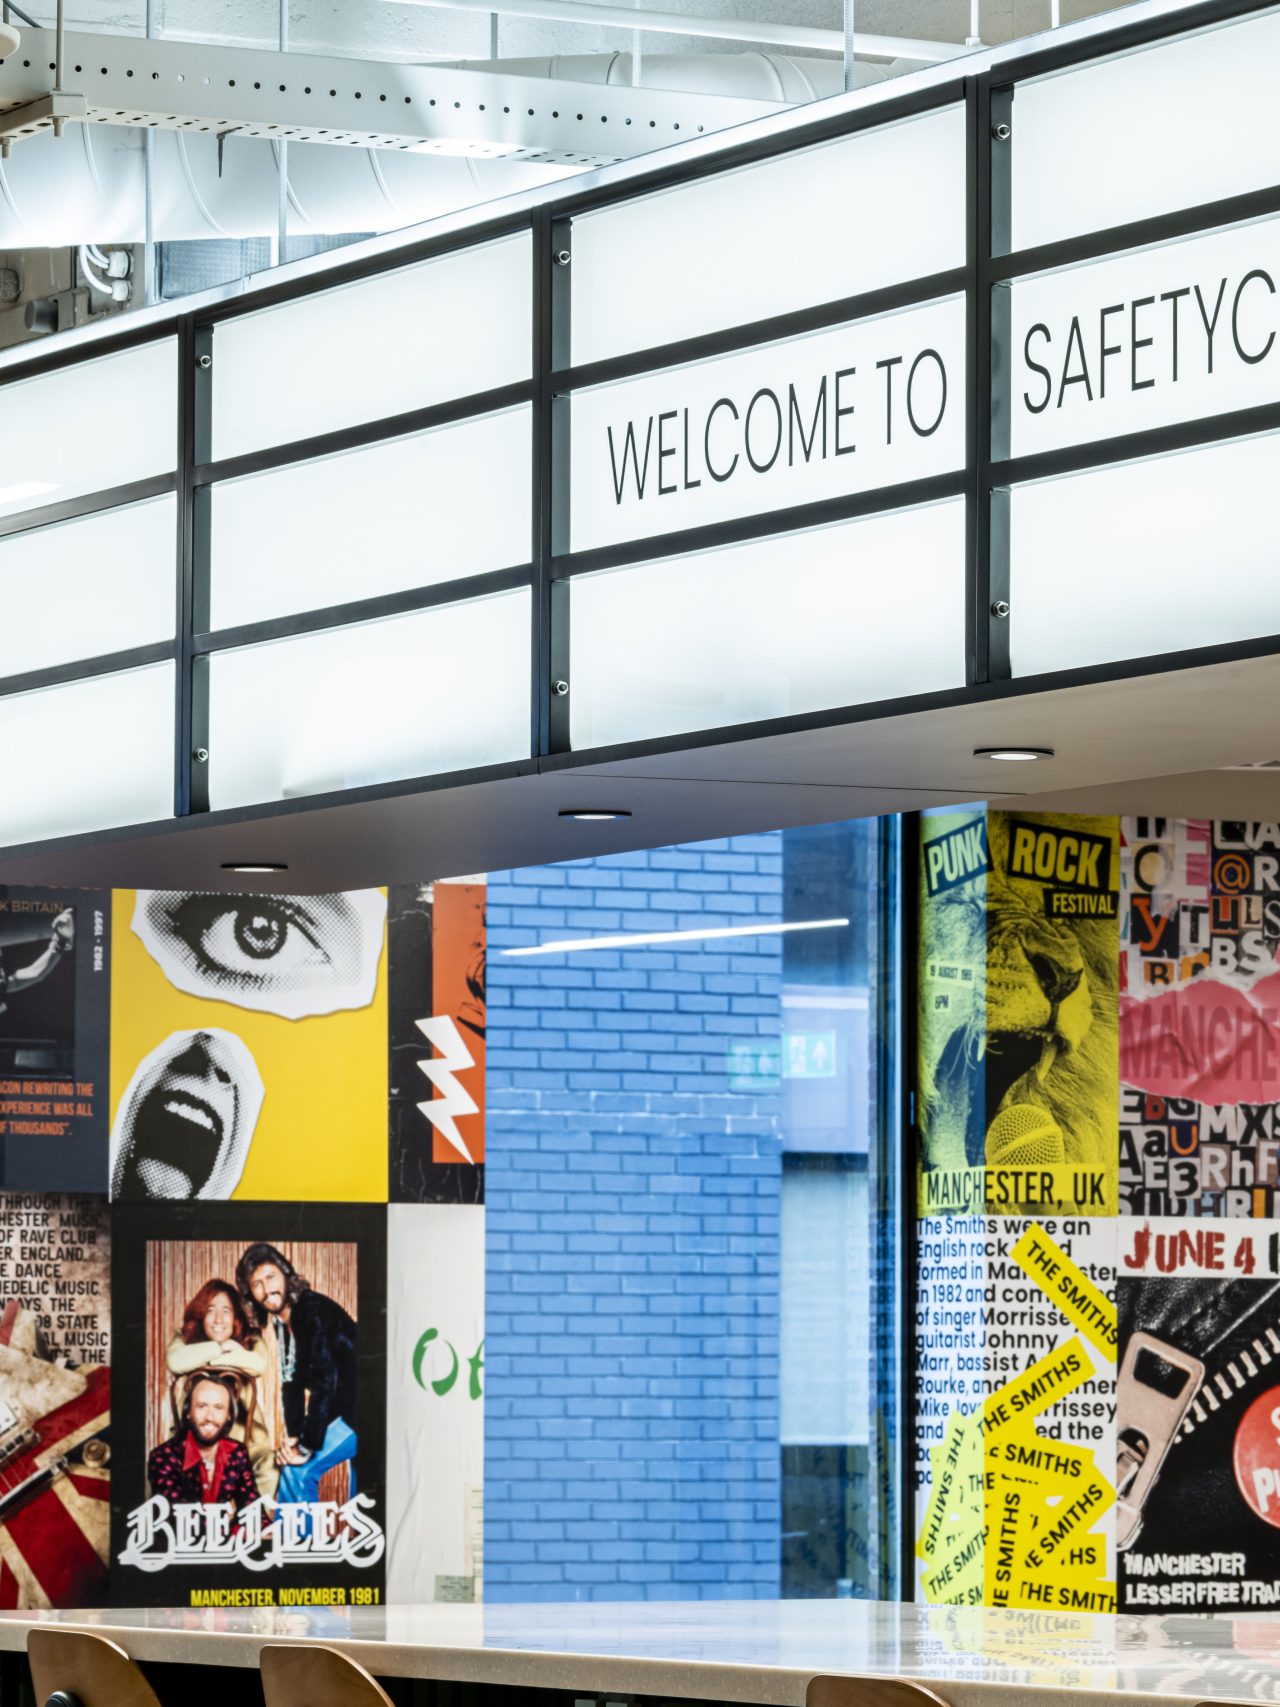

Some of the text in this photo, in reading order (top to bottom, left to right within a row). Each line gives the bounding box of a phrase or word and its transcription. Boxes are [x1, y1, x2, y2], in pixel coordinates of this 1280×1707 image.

[607, 348, 947, 505] WELCOME TO
[929, 824, 1103, 890] PUNK ROCK
[11, 901, 65, 913] BRITAIN
[1053, 893, 1115, 914] FESTIVAL
[93, 910, 104, 936] 1997
[23, 1082, 74, 1096] REWRITING
[76, 1083, 94, 1096] THE
[54, 1102, 74, 1116] WAS
[76, 1103, 93, 1117] ALL
[928, 1171, 1105, 1209] MANCHESTER, UK
[59, 1212, 104, 1228] MUSIC
[917, 1218, 942, 1235] The
[946, 1217, 998, 1234] Smiths
[1063, 1220, 1091, 1235] an
[20, 1230, 55, 1245] RAVE
[61, 1230, 97, 1245] CLUB
[1124, 1219, 1225, 1272] JUNE
[1234, 1237, 1256, 1275] 4
[917, 1240, 967, 1263] English
[971, 1238, 1009, 1257] rock
[971, 1261, 983, 1280] in
[933, 1285, 962, 1302] 1982
[966, 1284, 996, 1302] and
[1027, 1240, 1061, 1281] THE
[1057, 1276, 1117, 1346] SMITHS
[50, 1298, 76, 1312] THE
[57, 1315, 98, 1329] STATE
[933, 1308, 976, 1332] singer
[65, 1332, 108, 1346] MUSIC
[917, 1330, 1058, 1355] guitarist Johnny
[80, 1349, 106, 1363] THE
[918, 1353, 953, 1375] Marr,
[958, 1351, 1019, 1372] bassist
[918, 1376, 970, 1396] Rourke,
[977, 1404, 1012, 1438] THE
[1010, 1354, 1081, 1412] SMITHS
[918, 1399, 949, 1417] Mike
[917, 1422, 943, 1440] and
[1068, 1421, 1103, 1440] the
[1004, 1443, 1082, 1477] SMITHS
[925, 1427, 965, 1555] THE SMITHS
[969, 1472, 995, 1492] THE
[1040, 1483, 1104, 1554] SMITHS
[996, 1492, 1020, 1583] SMITHS
[1124, 1552, 1246, 1577] MANCHESTER
[929, 1564, 953, 1595] THE
[191, 1587, 380, 1607] MANCHESTER, NOVEMBER 1981
[1020, 1581, 1054, 1603] THE
[1125, 1581, 1195, 1605] LESSER
[1196, 1581, 1240, 1605] FREE
